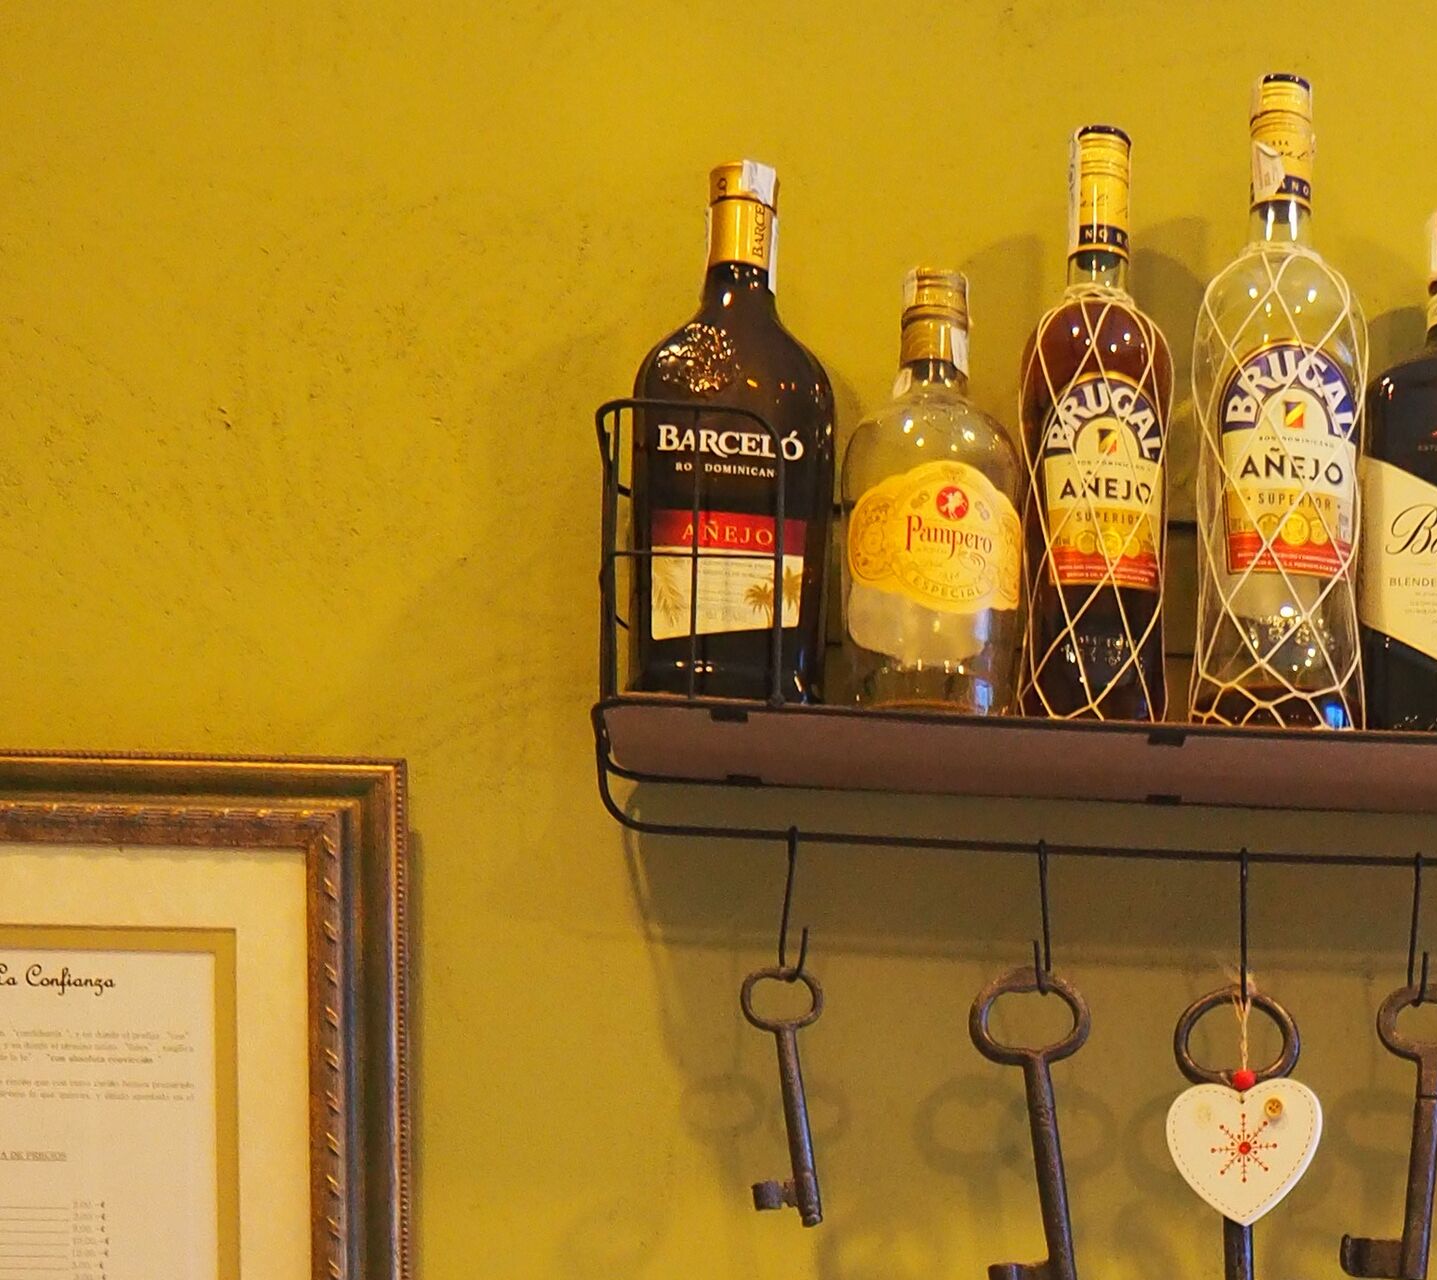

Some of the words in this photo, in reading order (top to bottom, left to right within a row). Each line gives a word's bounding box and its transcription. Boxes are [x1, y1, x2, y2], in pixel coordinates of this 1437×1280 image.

[1225, 350, 1354, 436] BRUGAL
[1046, 381, 1162, 460] BRUGAL
[657, 424, 804, 461] BARCELÓ
[675, 461, 698, 472] RO
[705, 462, 776, 478] DOMINICAN
[1239, 447, 1344, 485] AÑEJO
[1059, 470, 1153, 505] AÑEJO
[682, 519, 774, 546] AÑEJO
[905, 514, 993, 560] Pampero
[912, 575, 983, 598] ESPECIAL
[25, 963, 116, 997] Confianza
